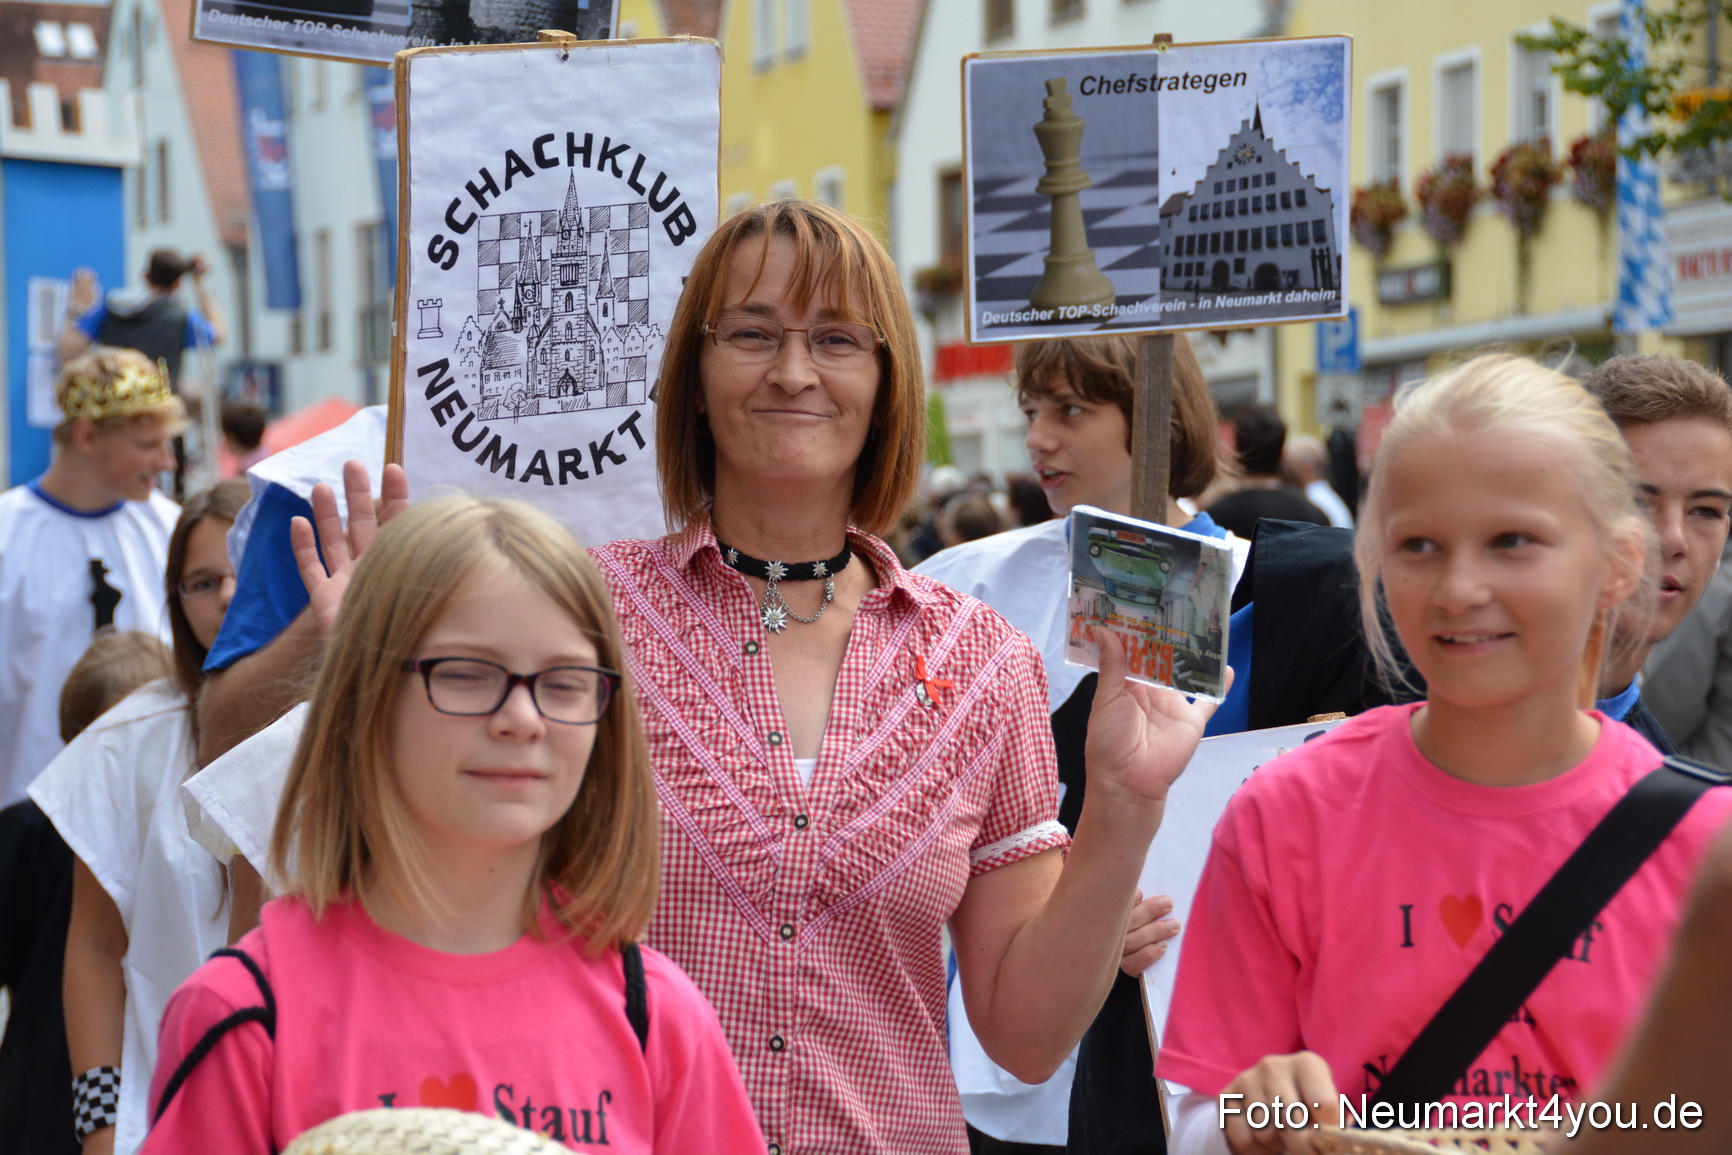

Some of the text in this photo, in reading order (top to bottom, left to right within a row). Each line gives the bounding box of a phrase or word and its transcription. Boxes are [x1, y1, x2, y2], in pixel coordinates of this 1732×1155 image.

[207, 8, 291, 31] Deutscher
[293, 18, 436, 48] TOP-Schachverein
[1080, 71, 1247, 96] Chefstrategen
[427, 131, 697, 271] SCHACHKLUB
[982, 307, 1054, 325] Deutscher
[1058, 299, 1186, 320] TOP-Schachverein
[1198, 295, 1211, 309] in
[1215, 291, 1282, 309] Neumarkt
[1285, 287, 1336, 303] daheim
[417, 357, 647, 486] NEUMARKT
[1398, 904, 1415, 948] I
[493, 1083, 612, 1146] Stauf
